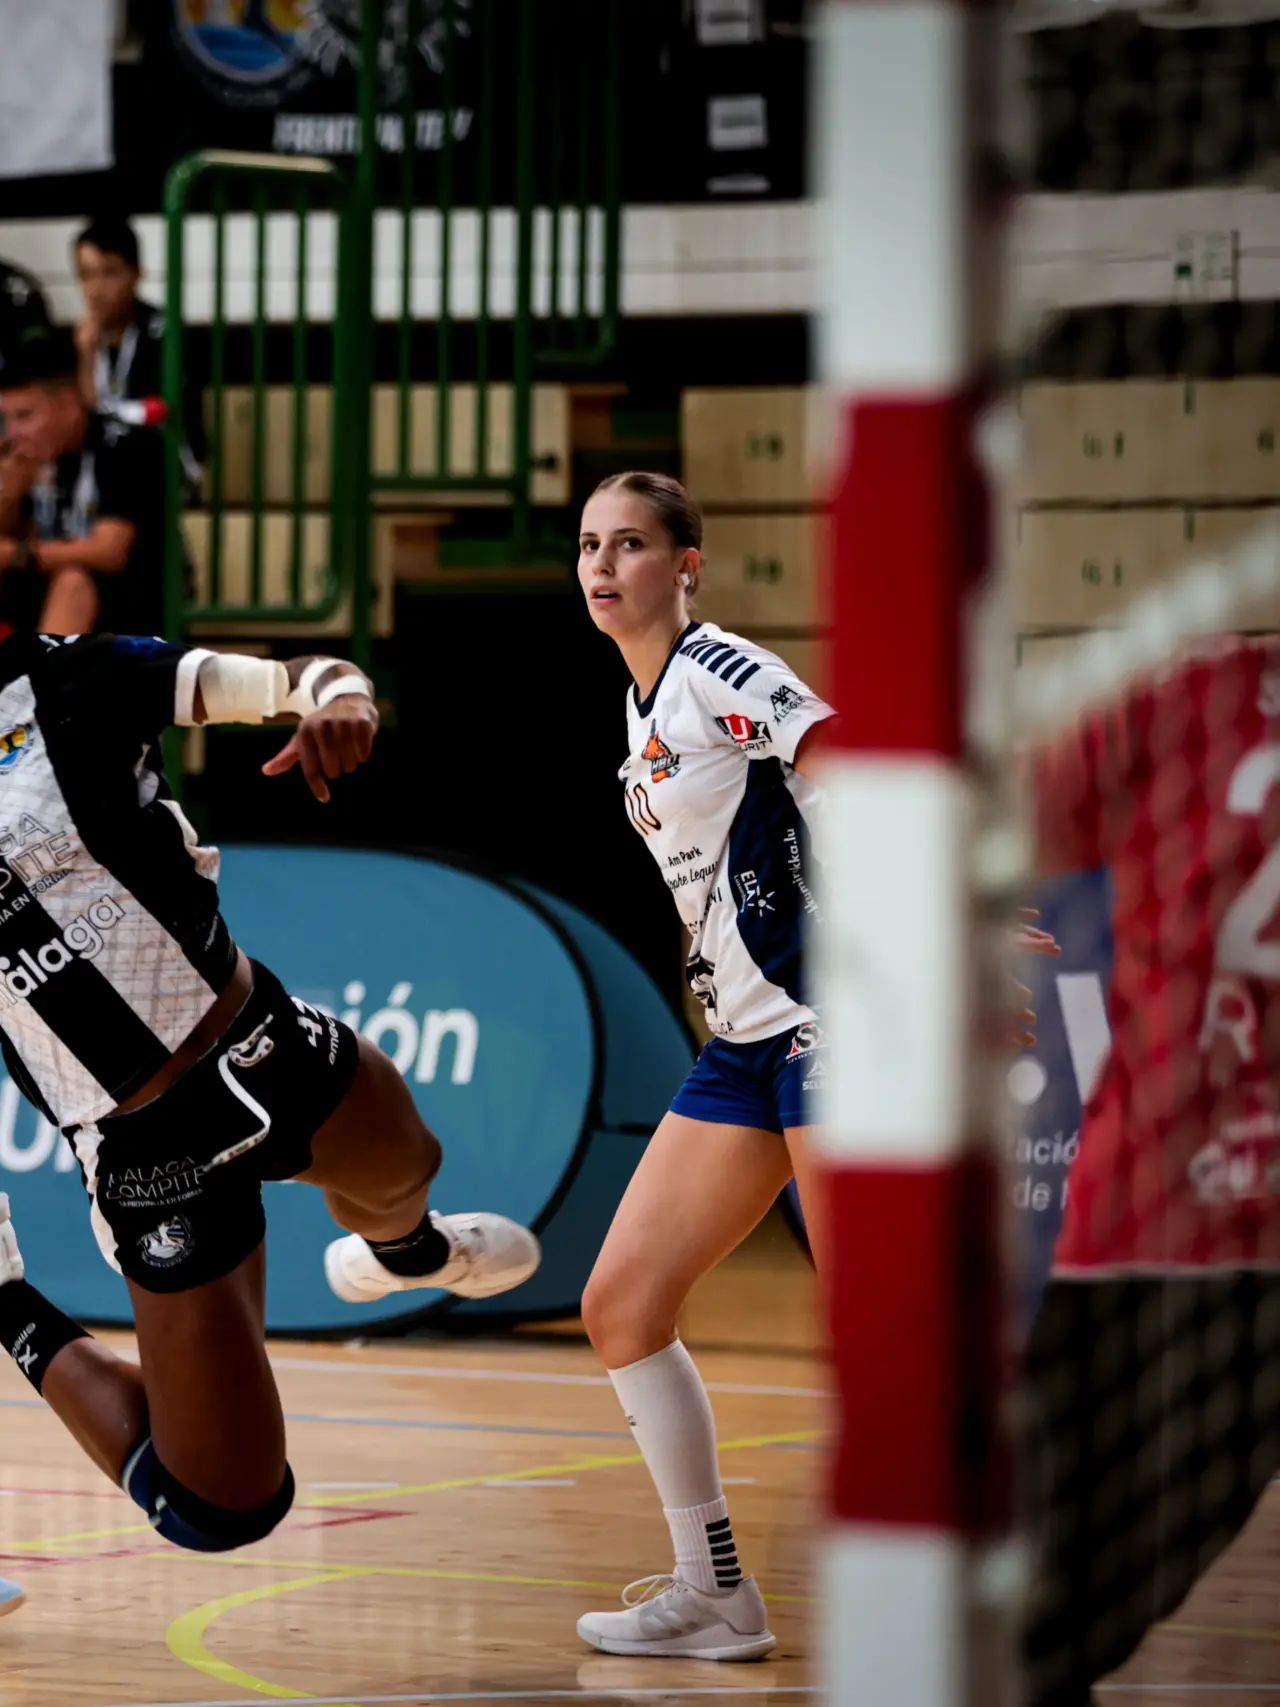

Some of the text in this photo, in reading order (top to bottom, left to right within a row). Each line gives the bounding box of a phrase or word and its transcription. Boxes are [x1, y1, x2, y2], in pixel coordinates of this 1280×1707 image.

[770, 685, 798, 712] AXA
[667, 846, 703, 867] Am Park
[668, 872, 689, 894] ophe
[740, 869, 757, 901] ELA
[12, 893, 32, 913] EN
